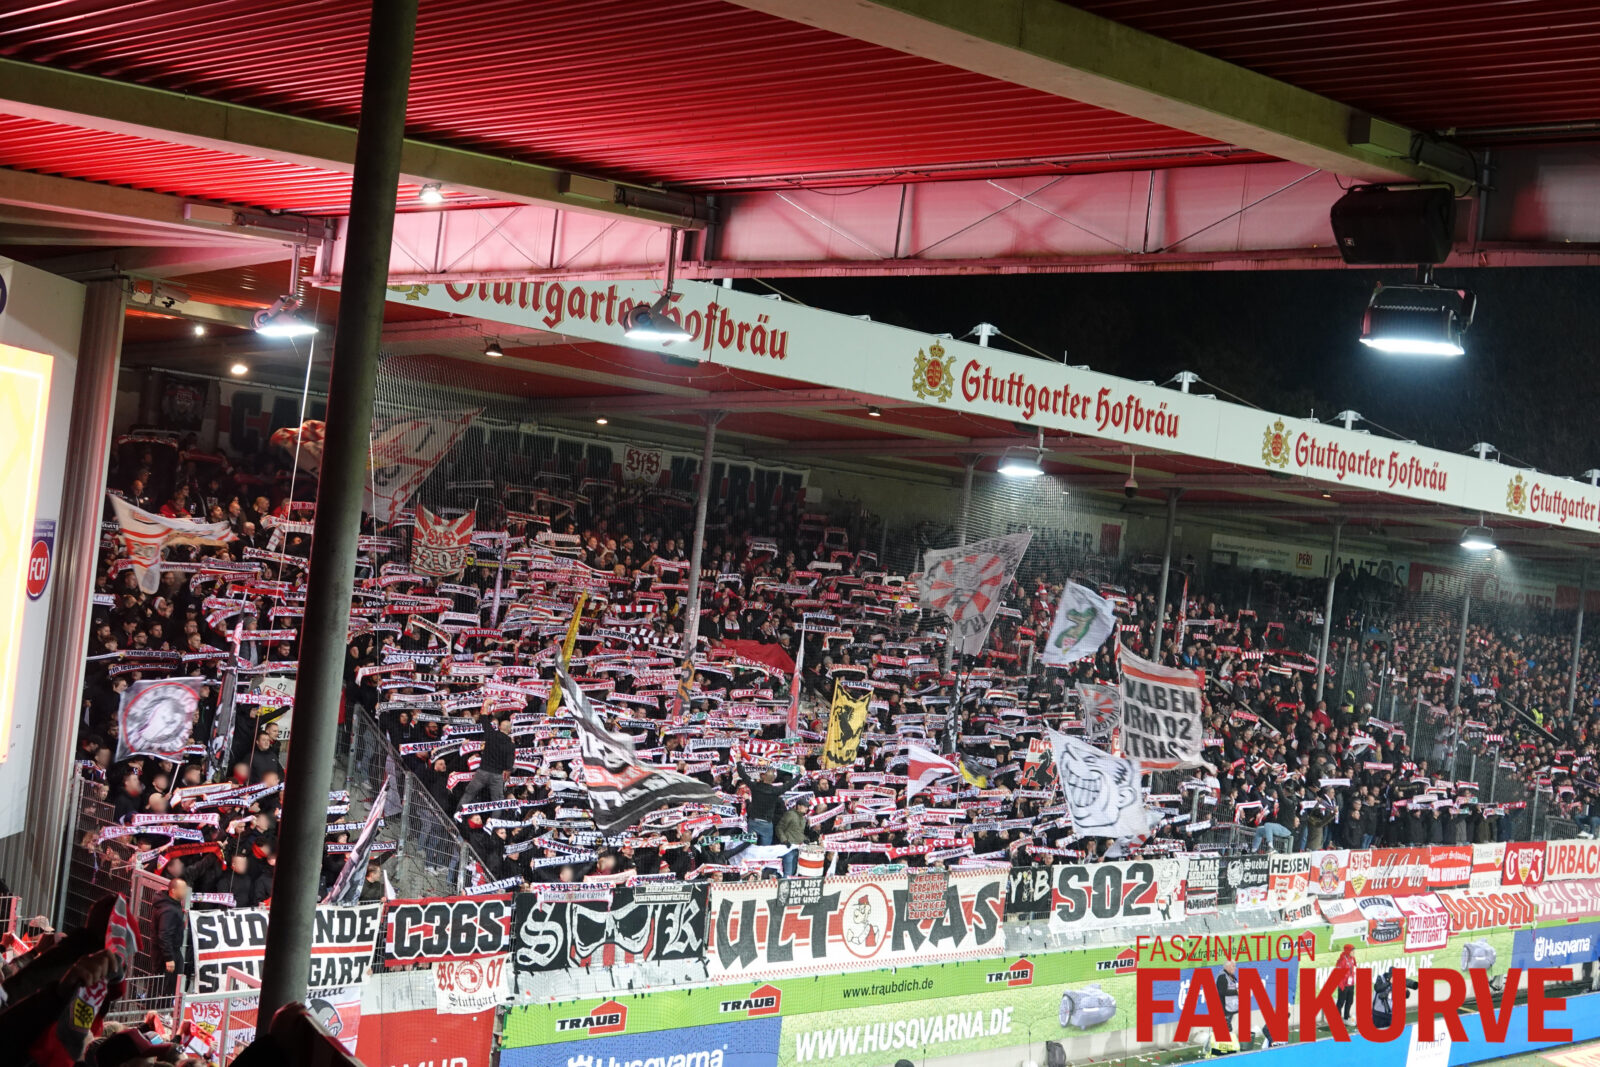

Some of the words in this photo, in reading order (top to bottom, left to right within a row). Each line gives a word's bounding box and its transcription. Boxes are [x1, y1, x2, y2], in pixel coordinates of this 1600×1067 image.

[961, 359, 1091, 421] Stuttgarter
[1095, 387, 1180, 439] Hofbräu
[1295, 432, 1386, 481] Stuttgarter
[1387, 451, 1448, 492] Hofbräu
[1529, 483, 1597, 525] Stuttgarter
[1297, 552, 1313, 567] PERI
[29, 557, 48, 581] FCH
[1164, 715, 1192, 741] 02
[1189, 859, 1219, 872] ULTRAS
[1272, 858, 1310, 874] HESSEN
[790, 880, 802, 889] DU
[804, 878, 822, 888] BIST
[914, 873, 944, 883] JEDER
[789, 887, 821, 897] IMMER
[912, 892, 944, 901] KEHRT
[1410, 930, 1443, 944] STUTTGART
[1544, 936, 1591, 955] Husqvarna
[1097, 957, 1135, 971] TRAUB
[987, 970, 1029, 983] TRAUB
[843, 977, 934, 999] www.traubdich.de
[448, 992, 498, 1009] Stuttgart
[721, 996, 775, 1012] TRAUB
[557, 1013, 620, 1031] TRAUB
[796, 1006, 1014, 1062] WWW.HUSQVARNA.DE
